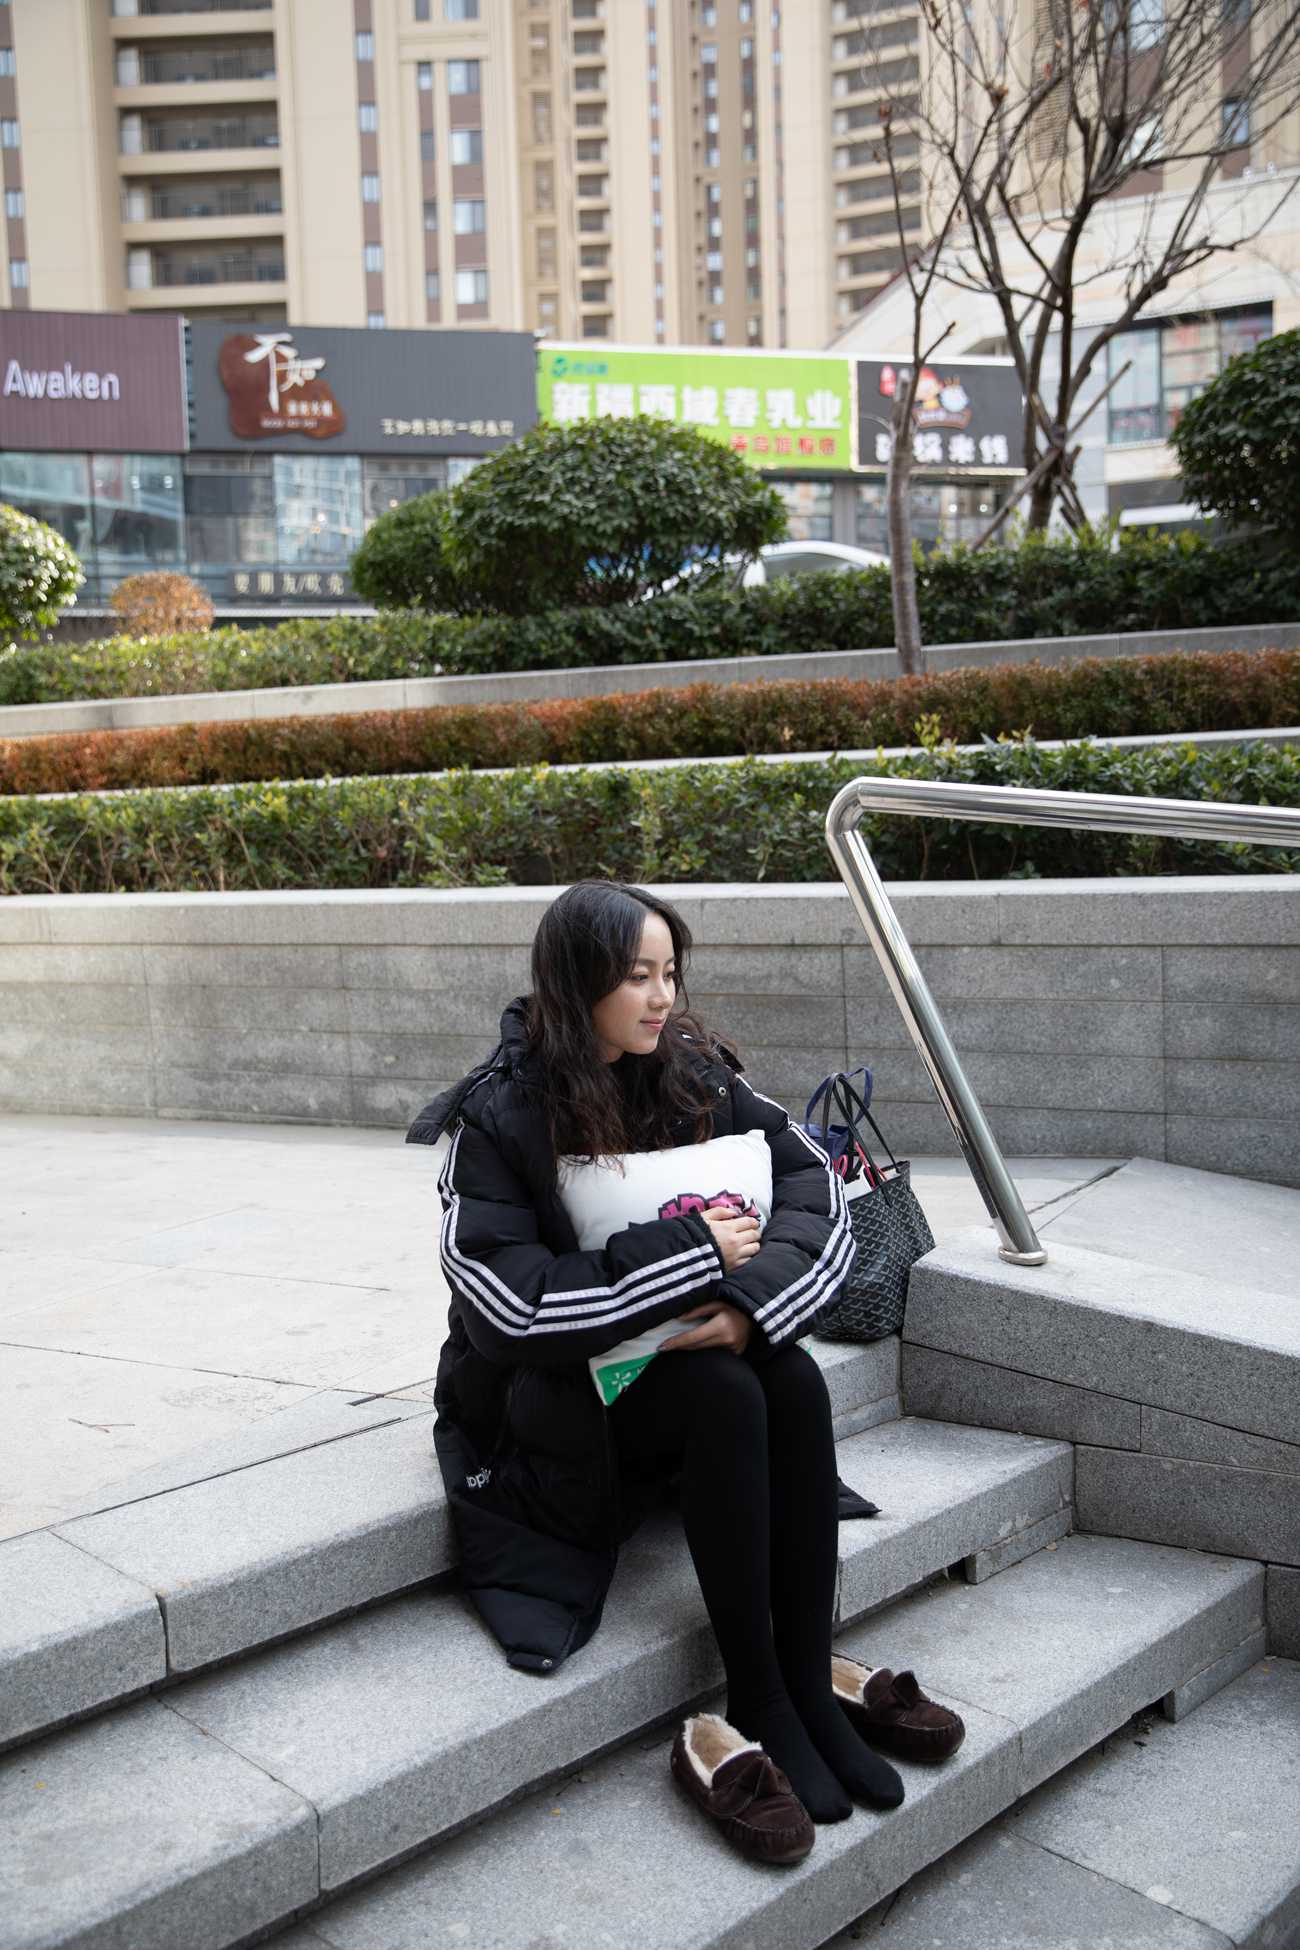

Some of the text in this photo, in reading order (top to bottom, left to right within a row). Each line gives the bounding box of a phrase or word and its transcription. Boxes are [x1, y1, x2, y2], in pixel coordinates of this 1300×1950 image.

[3, 360, 120, 400] Awaken
[552, 382, 842, 429] 新疆西域春乳业
